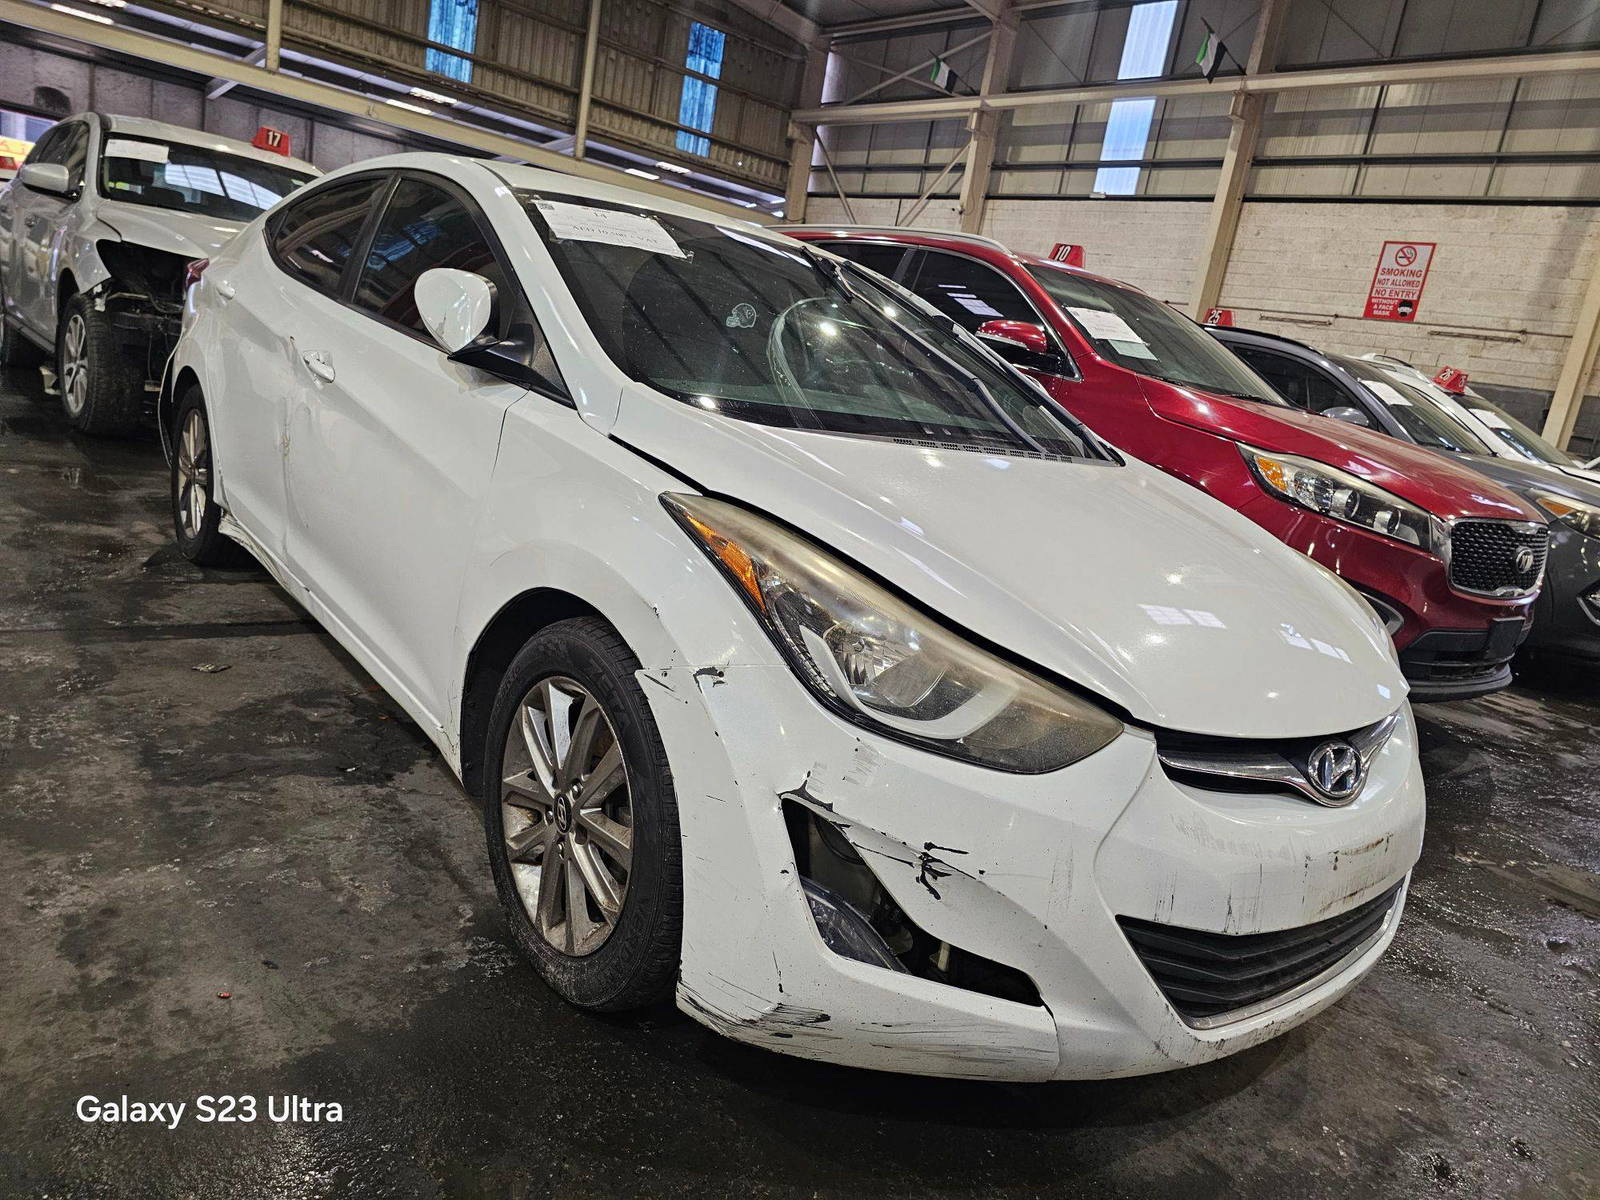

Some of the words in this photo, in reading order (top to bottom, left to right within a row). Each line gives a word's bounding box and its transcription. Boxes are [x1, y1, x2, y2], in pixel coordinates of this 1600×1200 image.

[267, 131, 282, 147] 17
[1054, 245, 1072, 262] 10
[1380, 268, 1423, 278] SMOKING
[1376, 278, 1391, 286] NOT
[1391, 279, 1421, 288] ALLOWED
[1374, 289, 1387, 297] NO
[1389, 289, 1417, 298] ENTRY
[1208, 310, 1223, 324] 25
